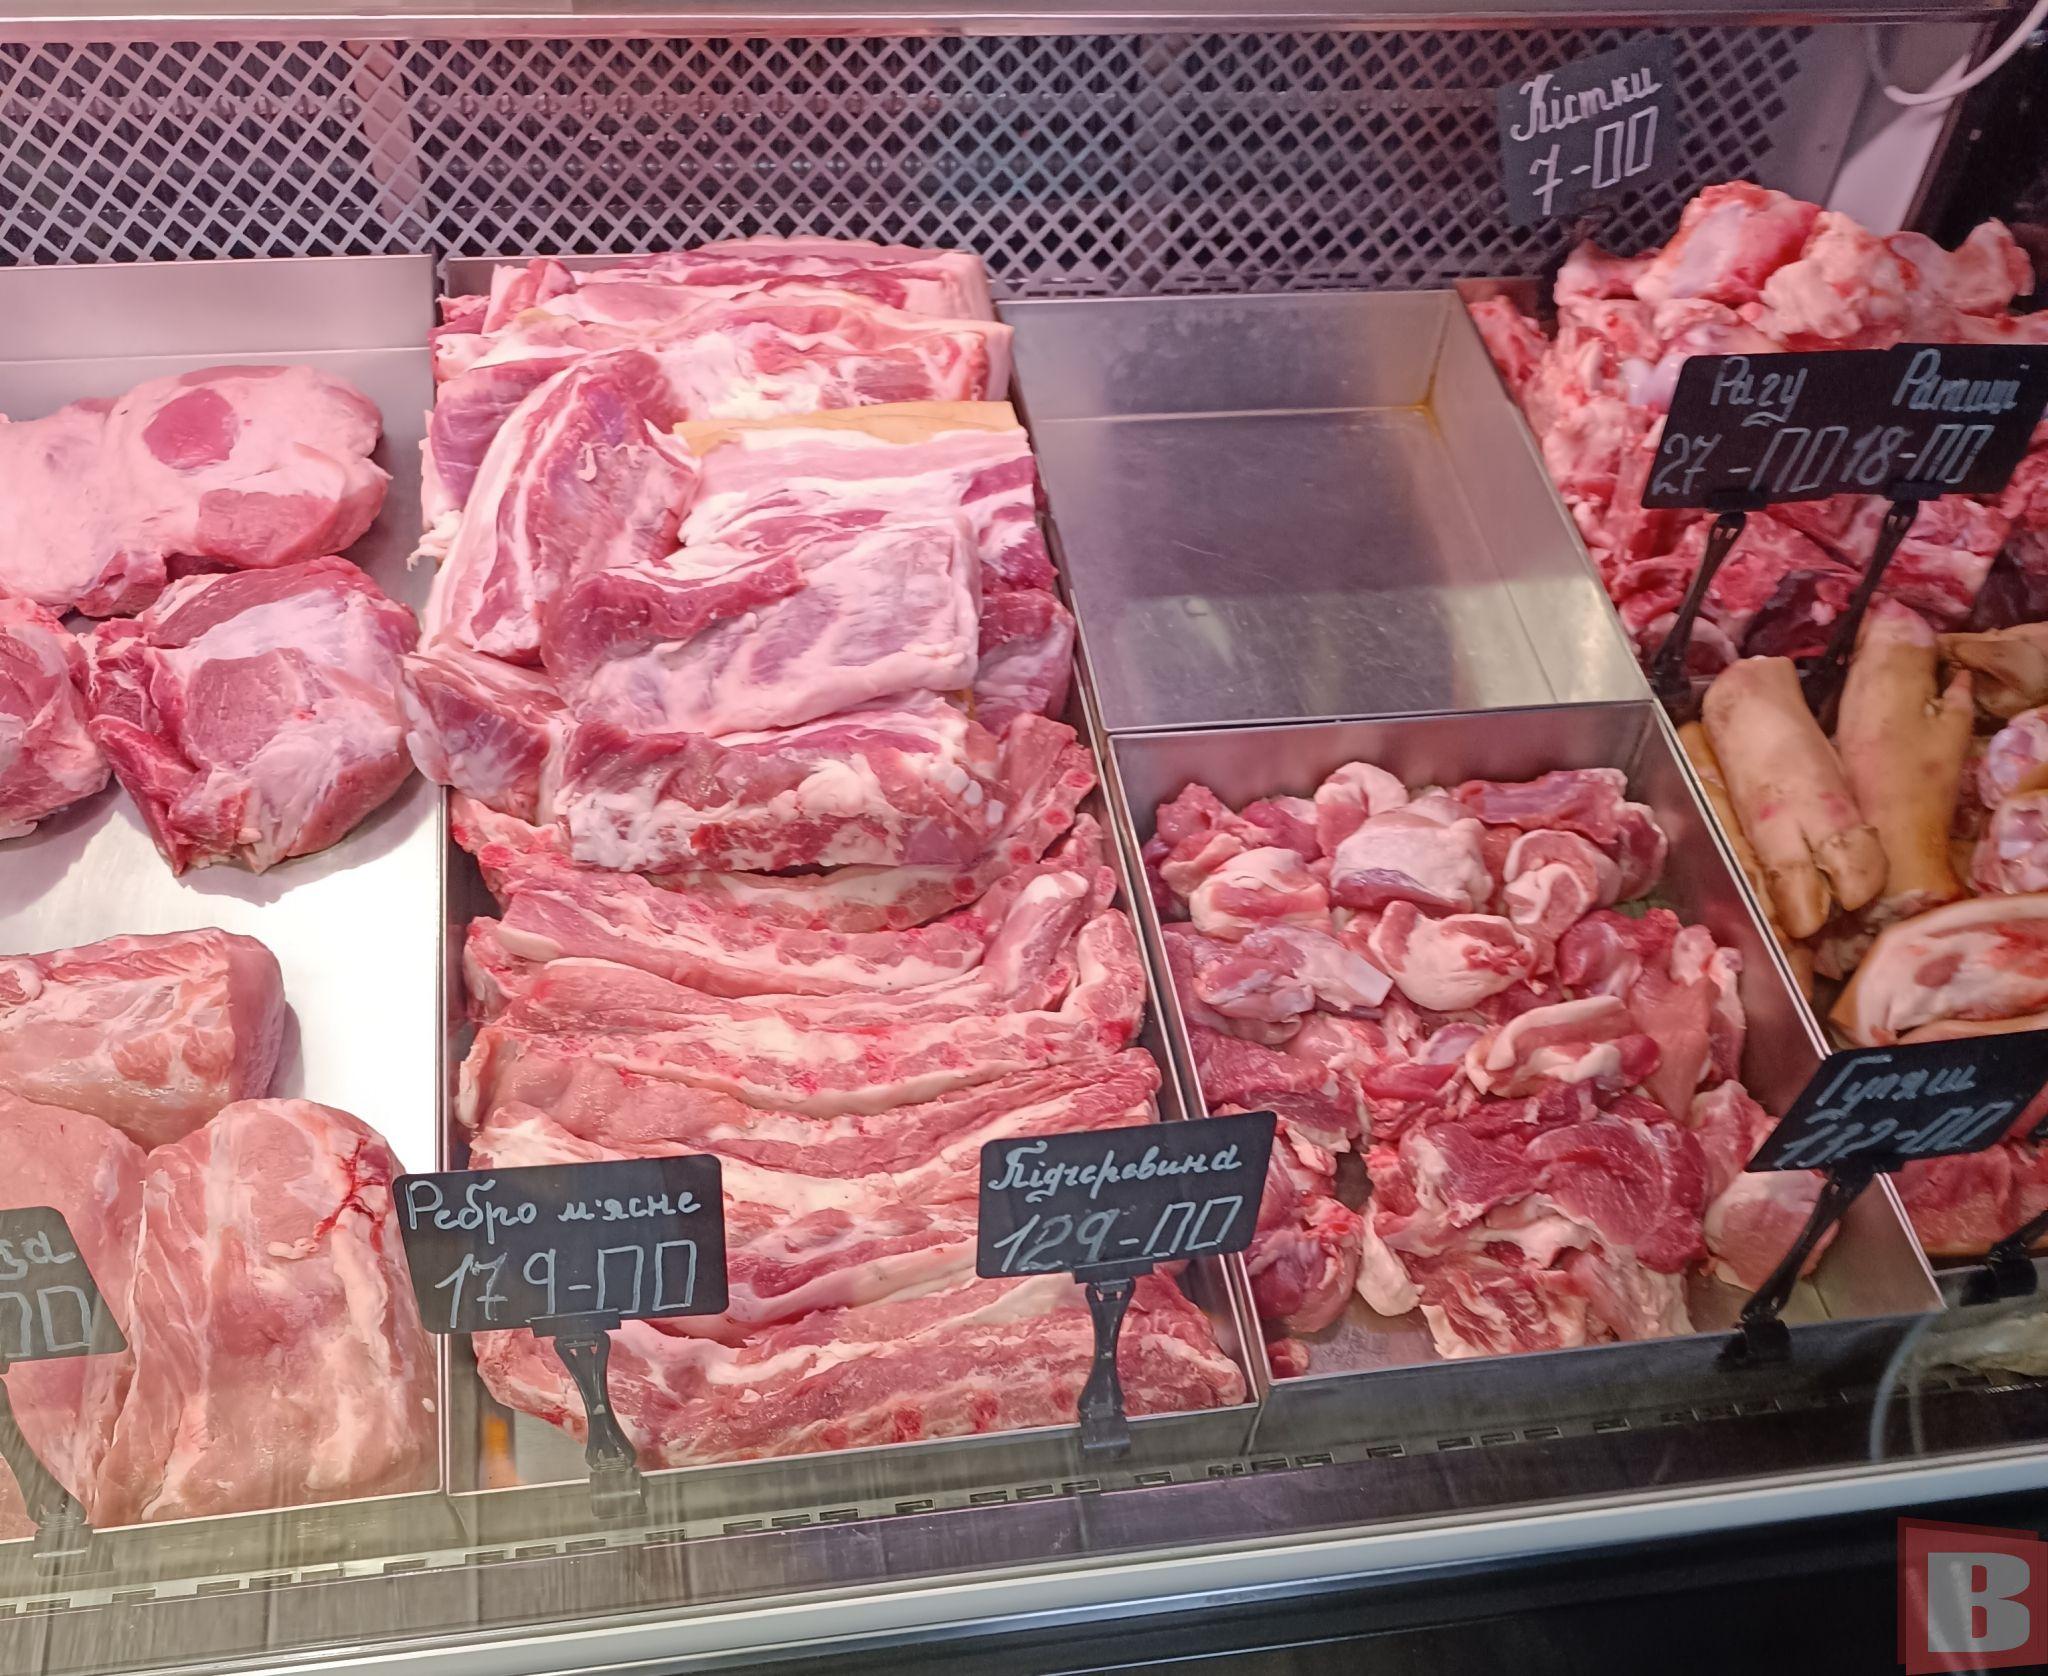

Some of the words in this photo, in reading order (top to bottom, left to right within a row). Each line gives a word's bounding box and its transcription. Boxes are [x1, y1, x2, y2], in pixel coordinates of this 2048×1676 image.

[1510, 67, 1663, 142] Кістки
[1711, 355, 1809, 427] Рагу
[988, 1140, 1243, 1204] Підчеревина
[405, 1179, 538, 1245] Ребро
